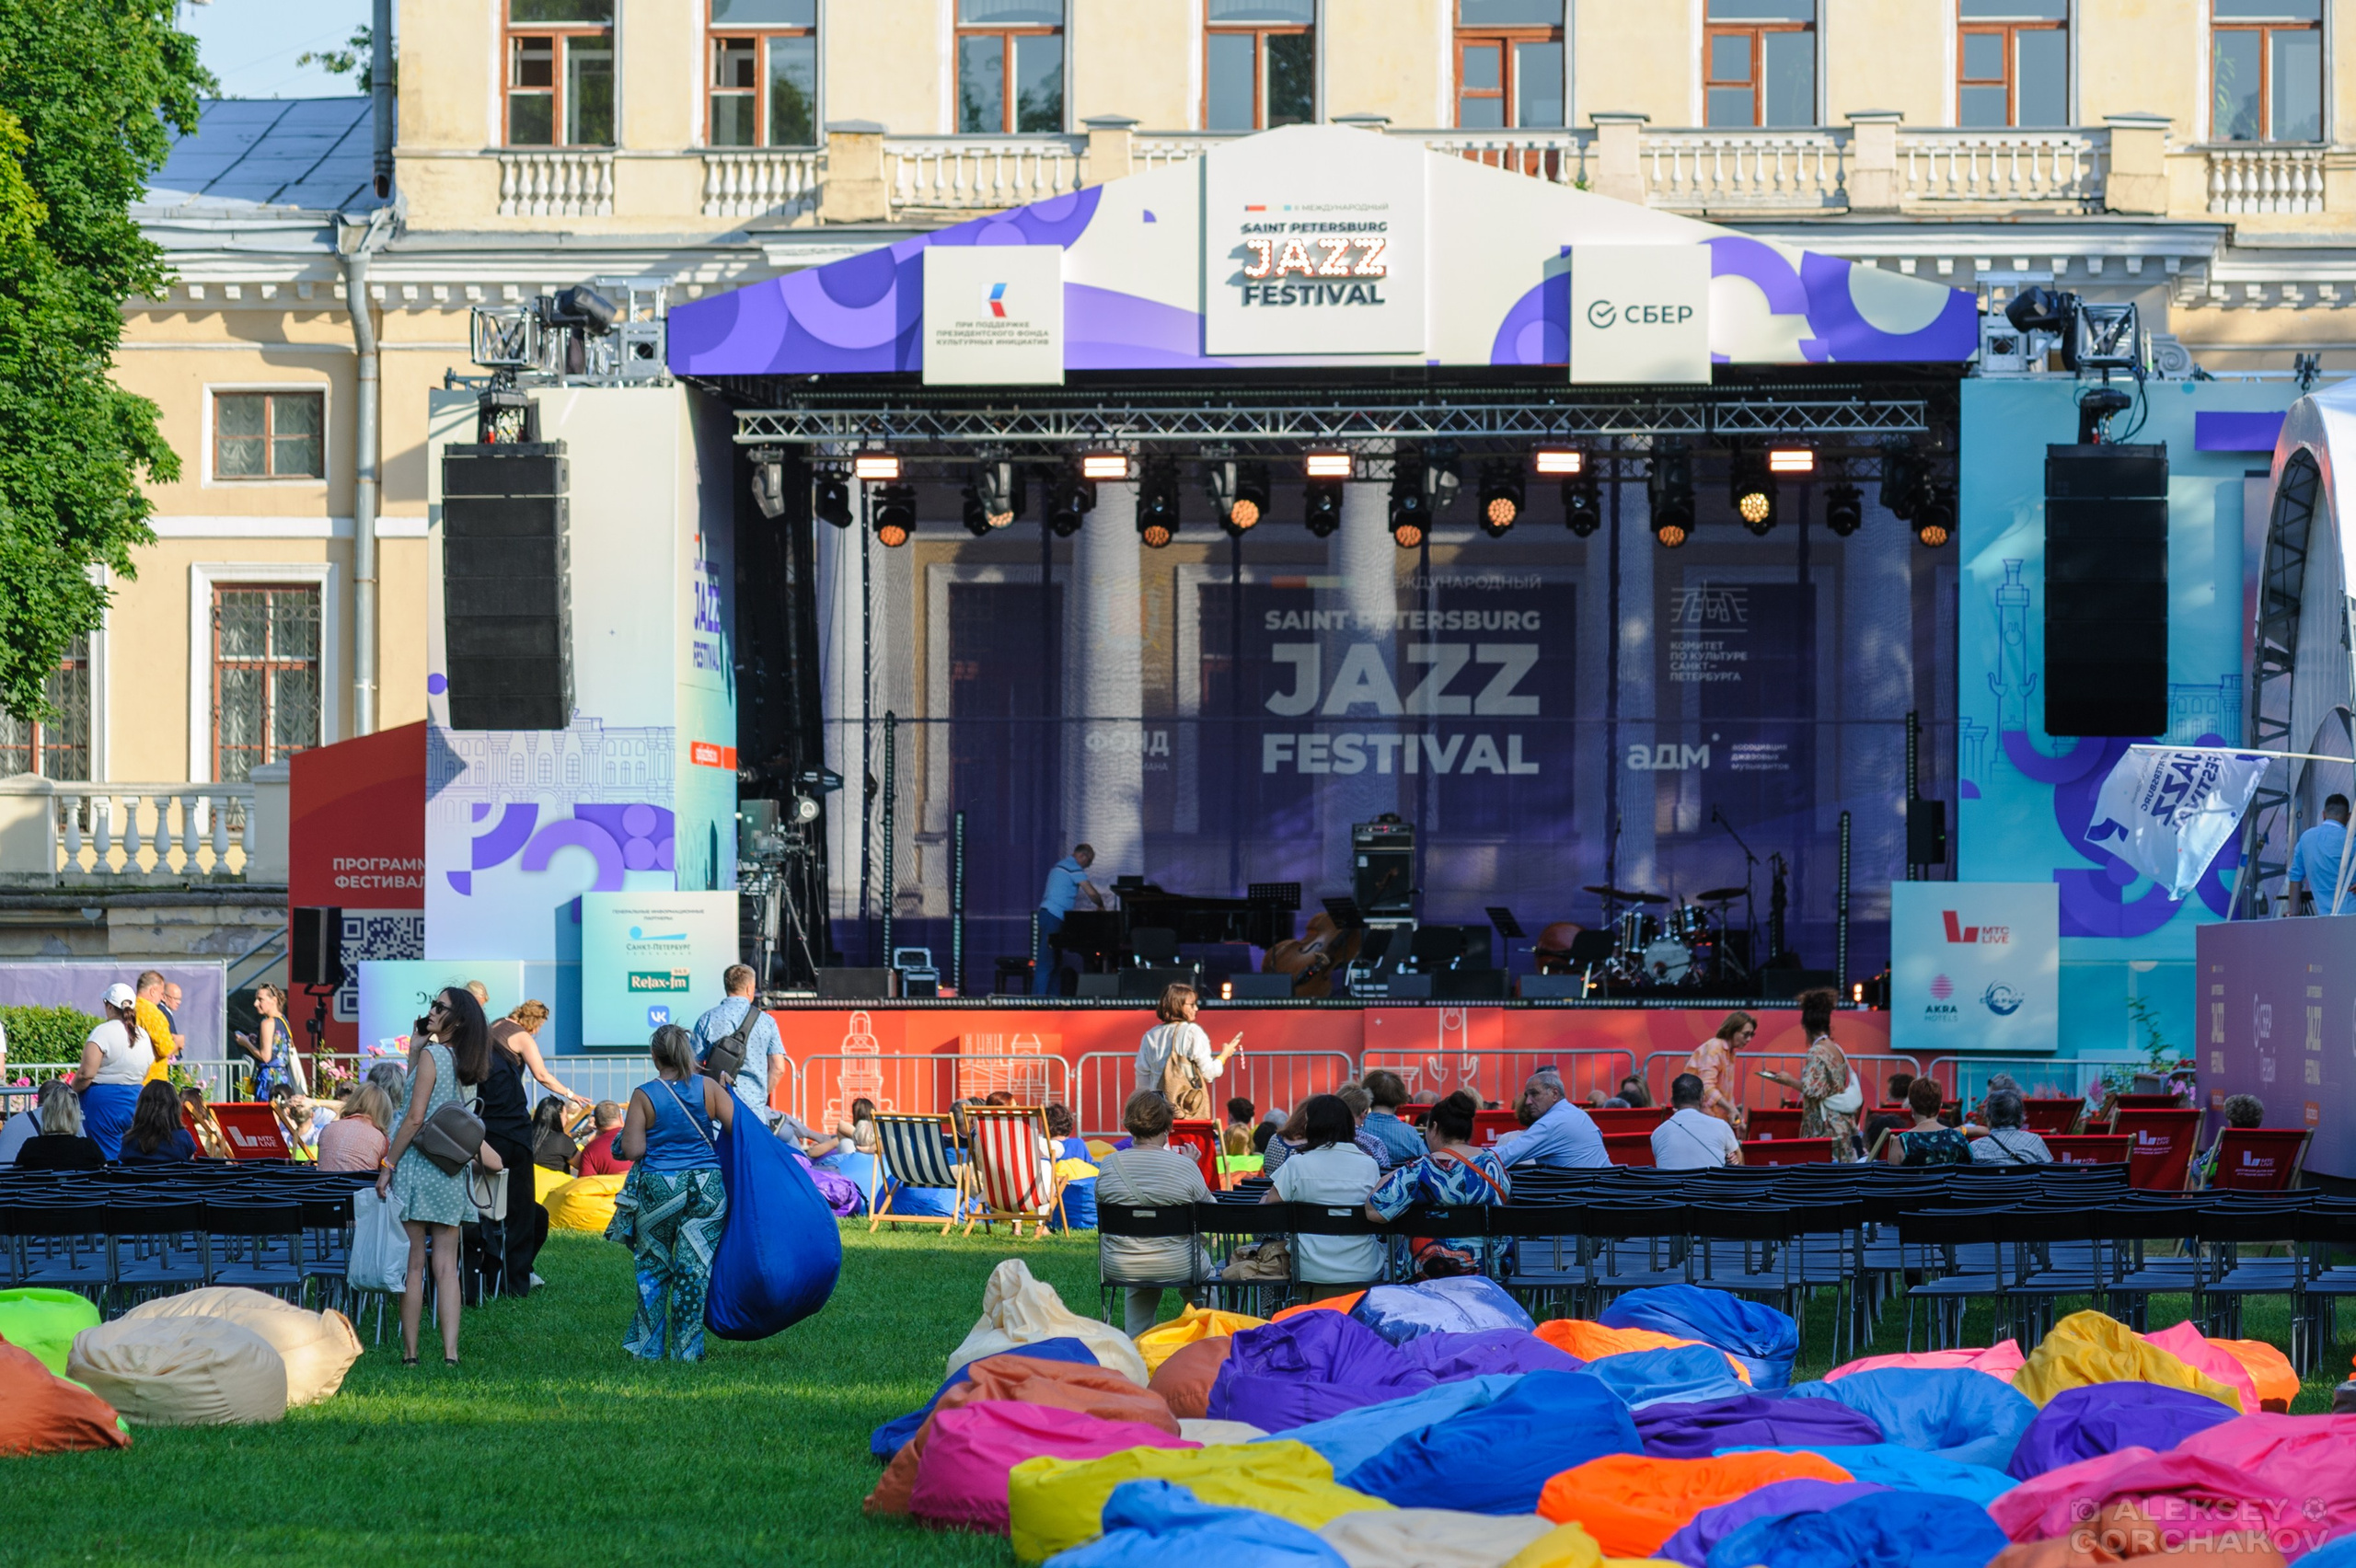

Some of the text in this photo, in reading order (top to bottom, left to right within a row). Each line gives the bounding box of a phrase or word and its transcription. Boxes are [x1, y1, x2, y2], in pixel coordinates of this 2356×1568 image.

[1242, 221, 1388, 233] SAINT PETERSBURG
[1243, 238, 1387, 279] JAZZ
[1243, 284, 1385, 306] FESTIVAL
[1625, 305, 1693, 324] СБЕР
[996, 339, 1049, 347] ИНИЦИАТИВ
[1265, 609, 1541, 631] SAINT PTERSBURG
[1669, 640, 1724, 651] КОМИТЕТ
[1669, 651, 1748, 662] ПО КУЛЬТУРЕ
[1265, 642, 1541, 716] JAZZ
[1669, 673, 1741, 682] ПЕТЕРБУРГА
[1262, 733, 1540, 775] FESTIVAL
[332, 858, 425, 871] ПРОГРАММ
[334, 875, 425, 889] ФЕСТИВАЛ
[1981, 935, 2010, 944] LIVE
[1924, 1005, 1958, 1013] AKRA
